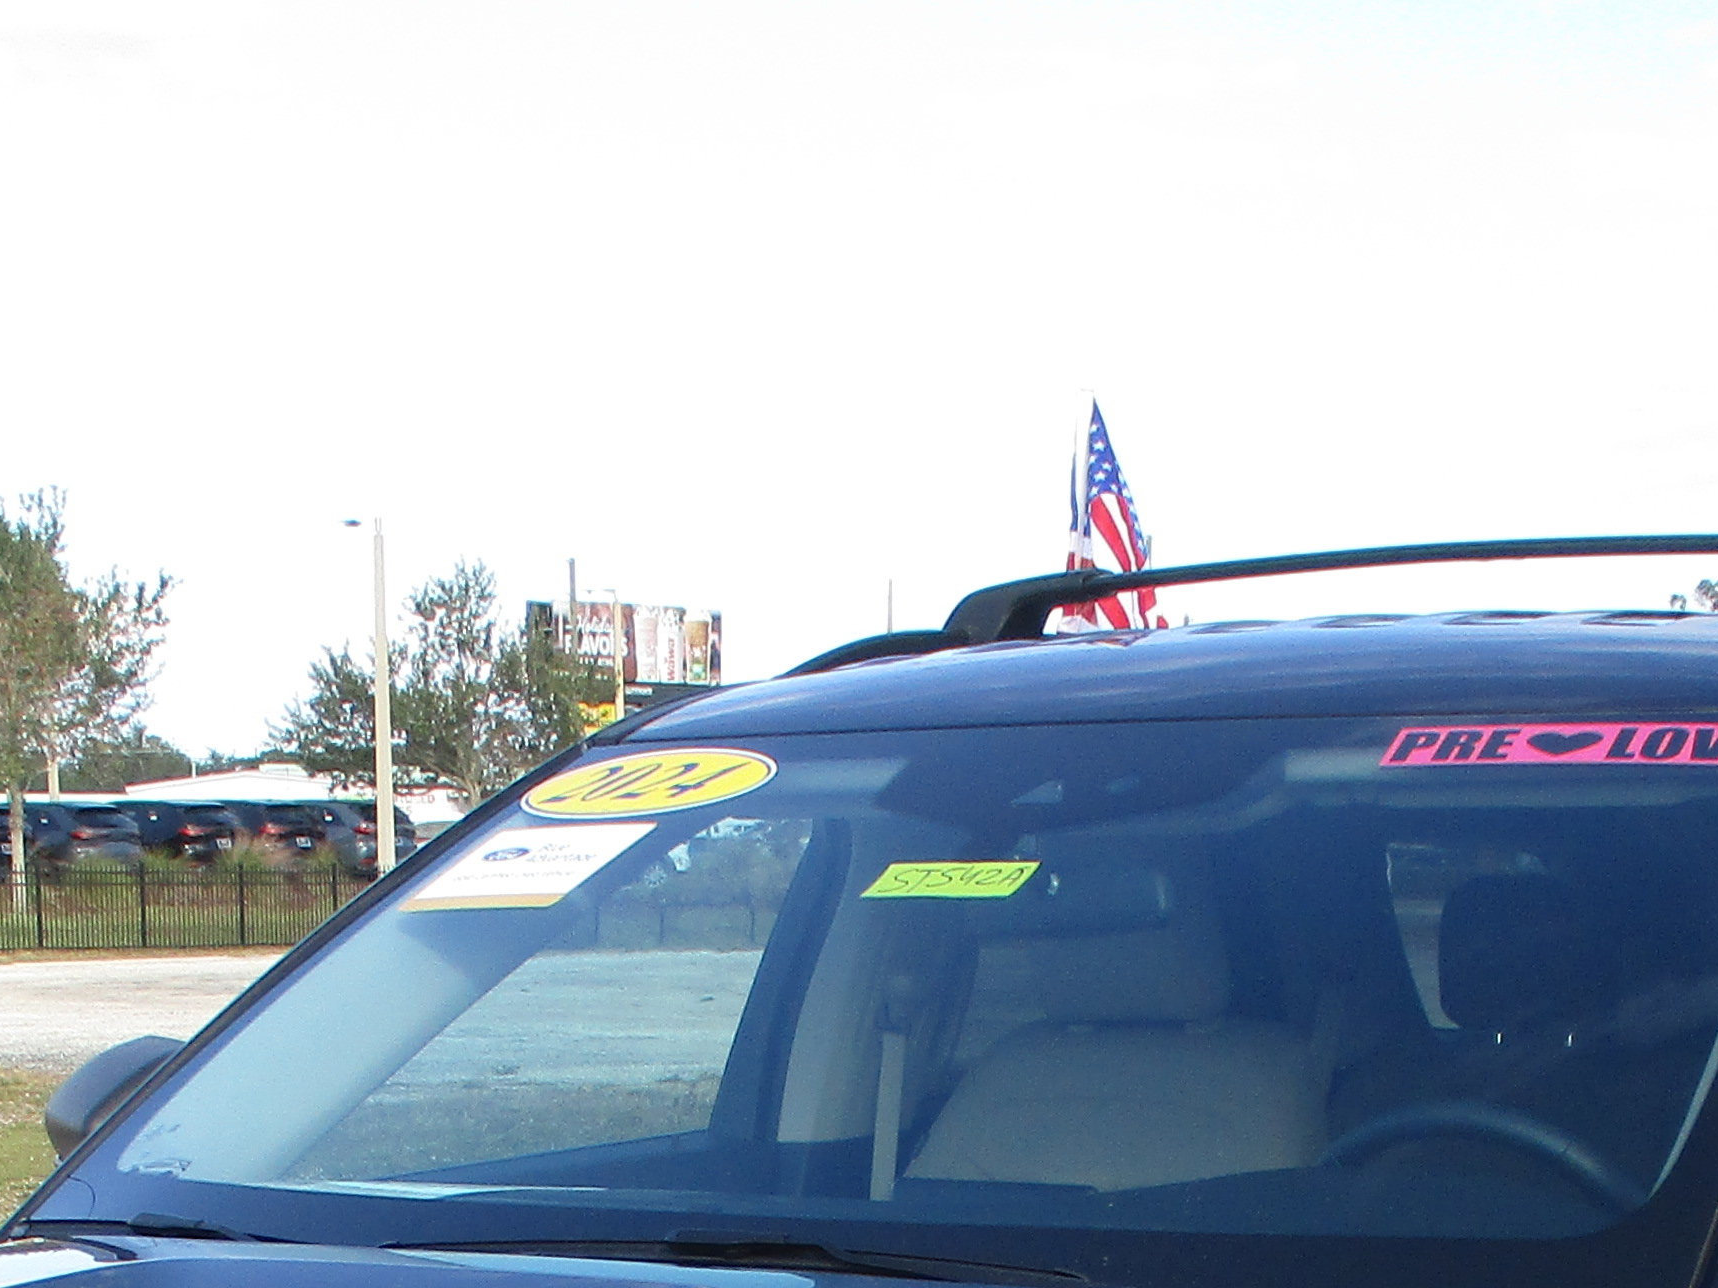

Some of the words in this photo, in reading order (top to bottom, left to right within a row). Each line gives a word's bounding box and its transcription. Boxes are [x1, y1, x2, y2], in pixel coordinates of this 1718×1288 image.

[564, 633, 629, 656] FAVOS
[1389, 728, 1523, 762] PRE
[539, 761, 753, 804] 2024
